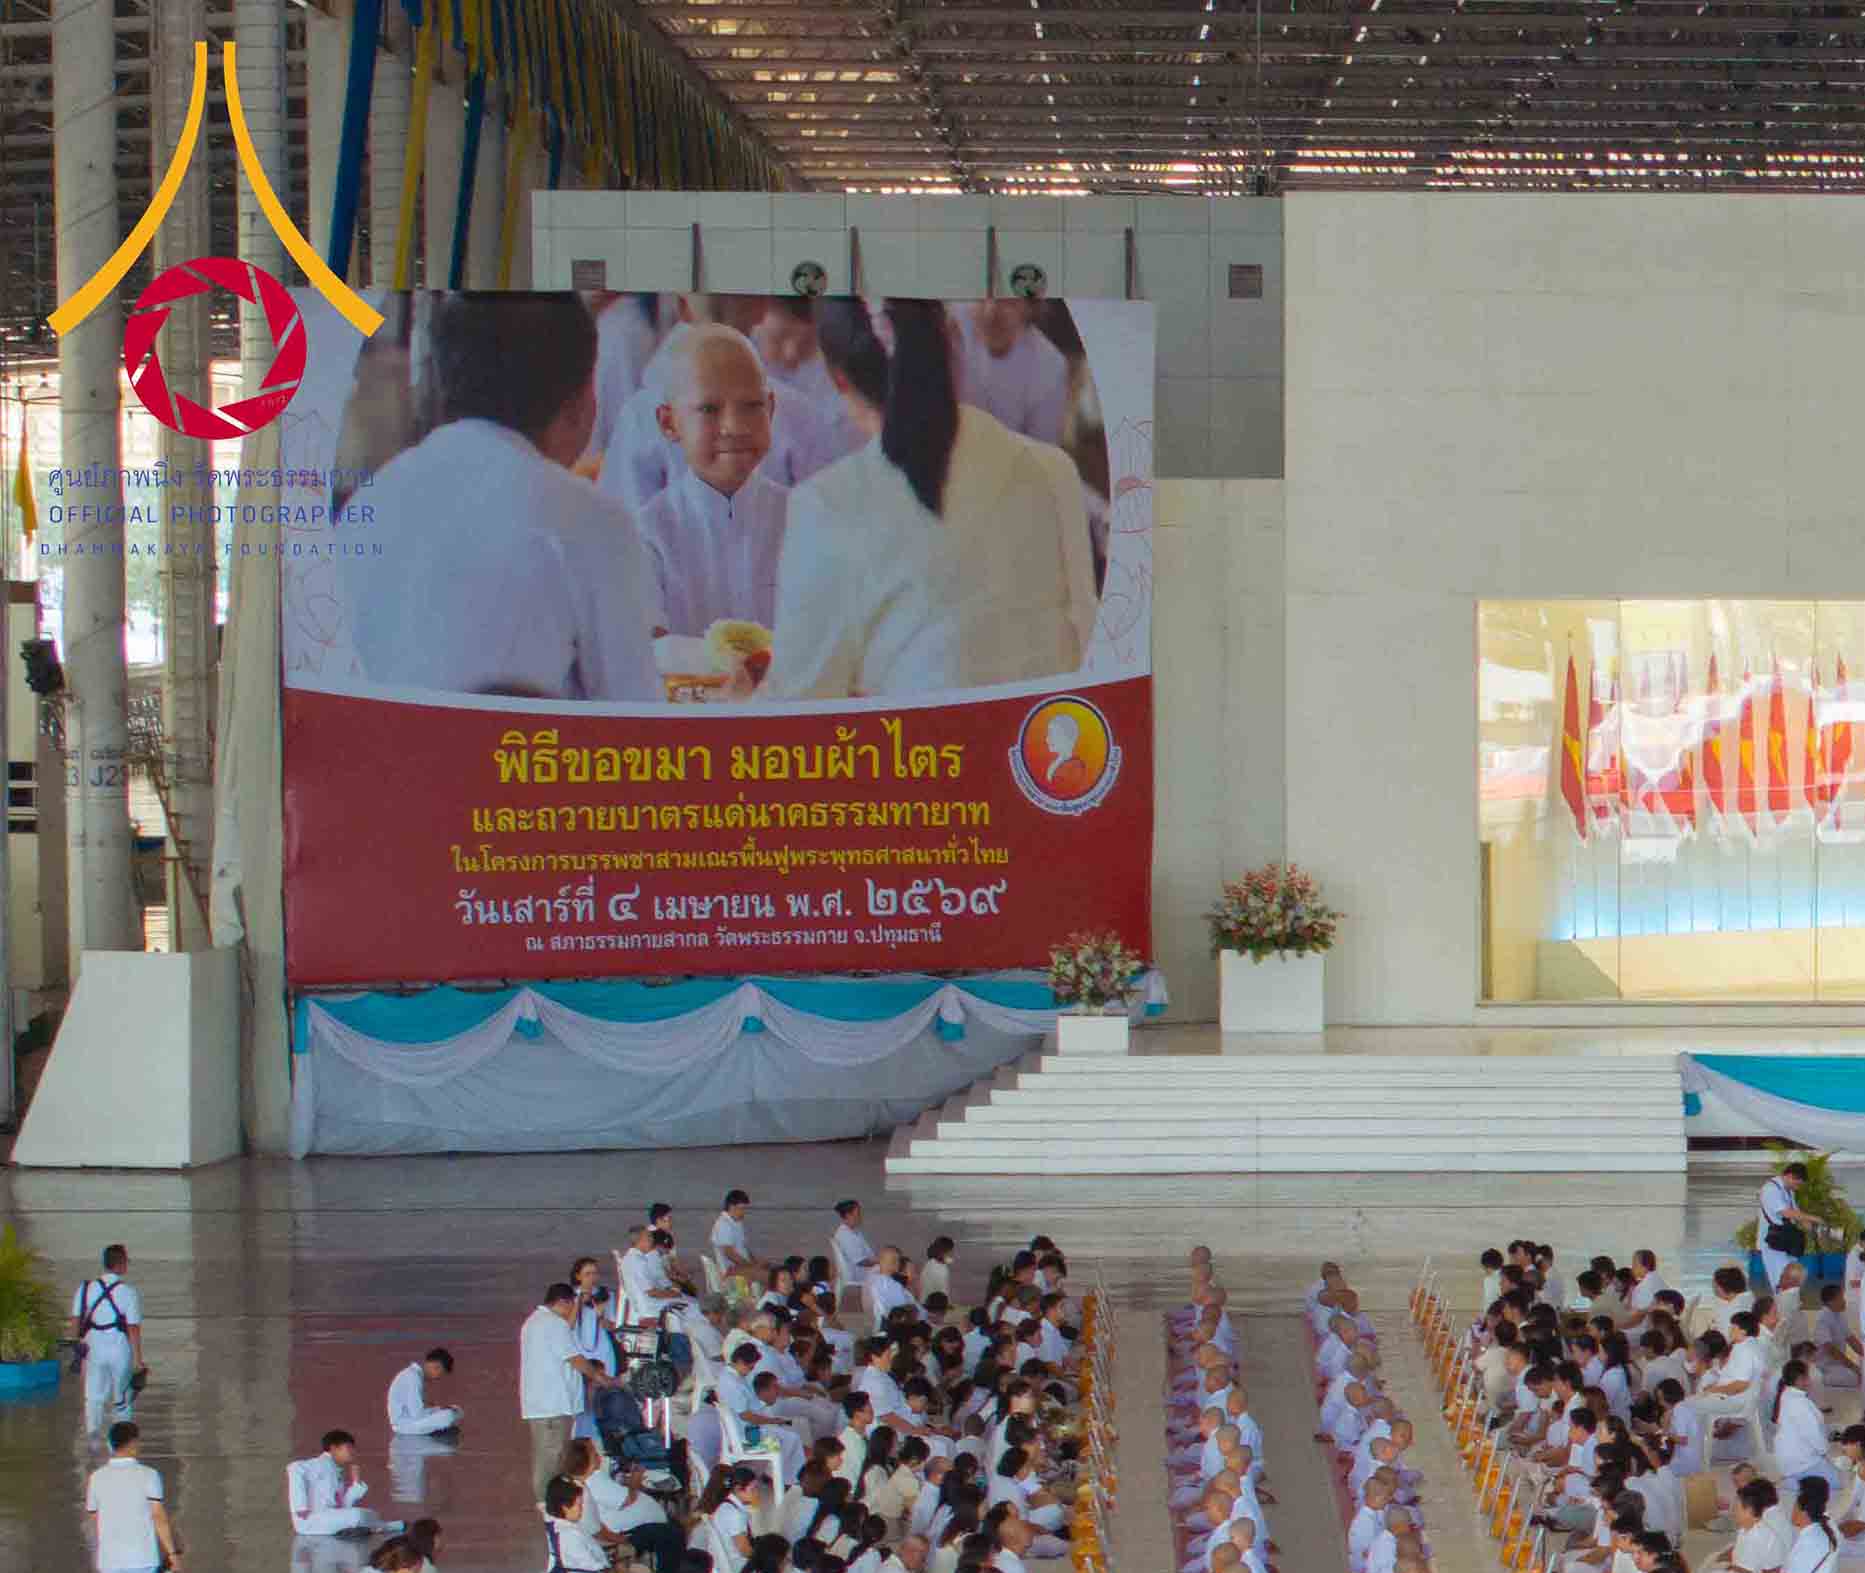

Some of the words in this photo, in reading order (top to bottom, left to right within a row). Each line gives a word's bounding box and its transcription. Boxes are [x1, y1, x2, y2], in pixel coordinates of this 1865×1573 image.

[493, 729, 712, 783] พิธีขอขมา
[730, 718, 964, 780] มอบผ้าไตร
[472, 793, 990, 832] และถวายบาตรแด่นาคธรรมทายาท
[455, 874, 595, 925] วันเสาร์ที่
[608, 883, 641, 921] ๔
[654, 894, 775, 920] เมษายน
[786, 889, 852, 918] พ.ศ.
[865, 878, 1007, 916] ๒๕๖๙
[715, 924, 848, 947] วัดพระธรรมกาย
[855, 921, 942, 949] จ.ปทุมธานี
